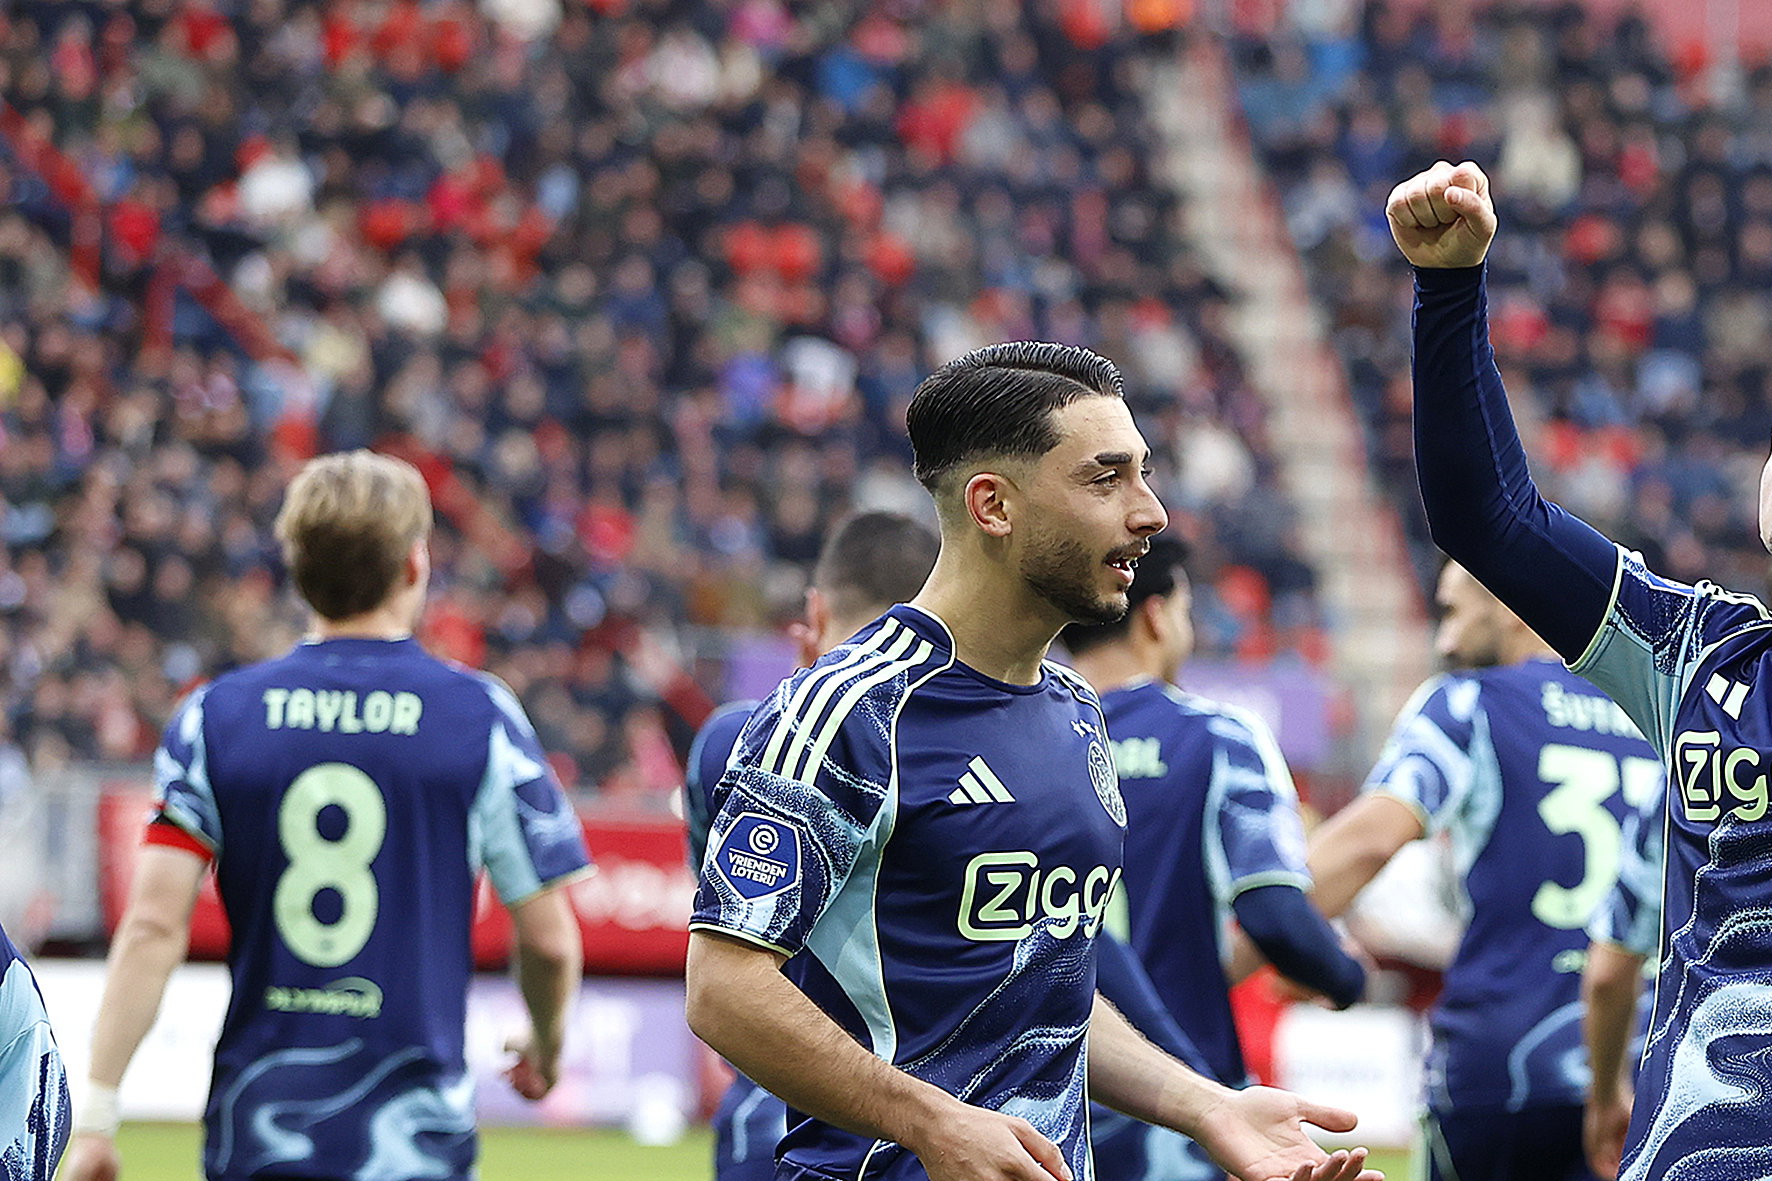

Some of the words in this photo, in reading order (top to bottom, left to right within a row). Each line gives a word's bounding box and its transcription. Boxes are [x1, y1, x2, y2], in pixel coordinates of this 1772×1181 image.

[262, 687, 423, 736] TAYLOR
[272, 762, 387, 967] 8
[728, 852, 787, 879] VRIENDEN
[958, 851, 1122, 941] Zigg
